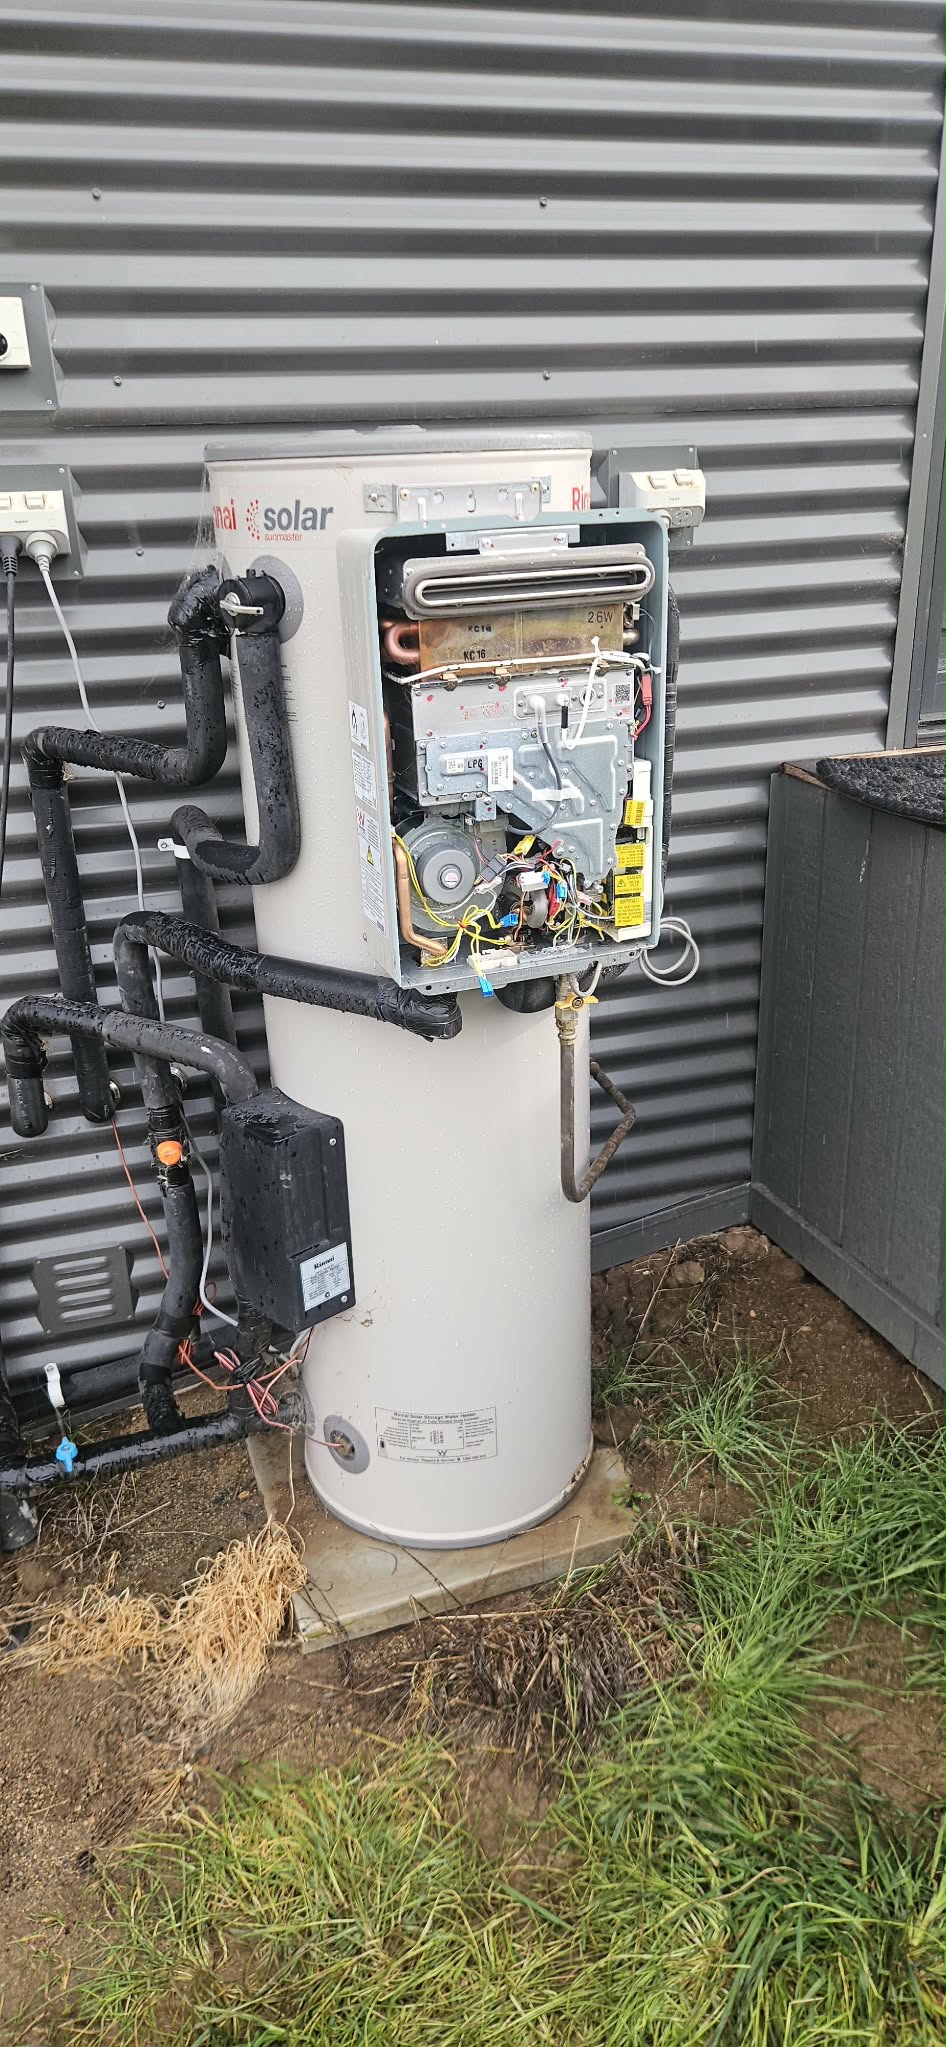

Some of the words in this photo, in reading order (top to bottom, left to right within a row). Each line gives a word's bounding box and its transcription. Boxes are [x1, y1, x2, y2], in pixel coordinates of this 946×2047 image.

[263, 499, 334, 531] solar
[264, 533, 302, 542] sunmaster
[467, 758, 483, 769] LPG
[313, 1255, 335, 1270] Rinnai
